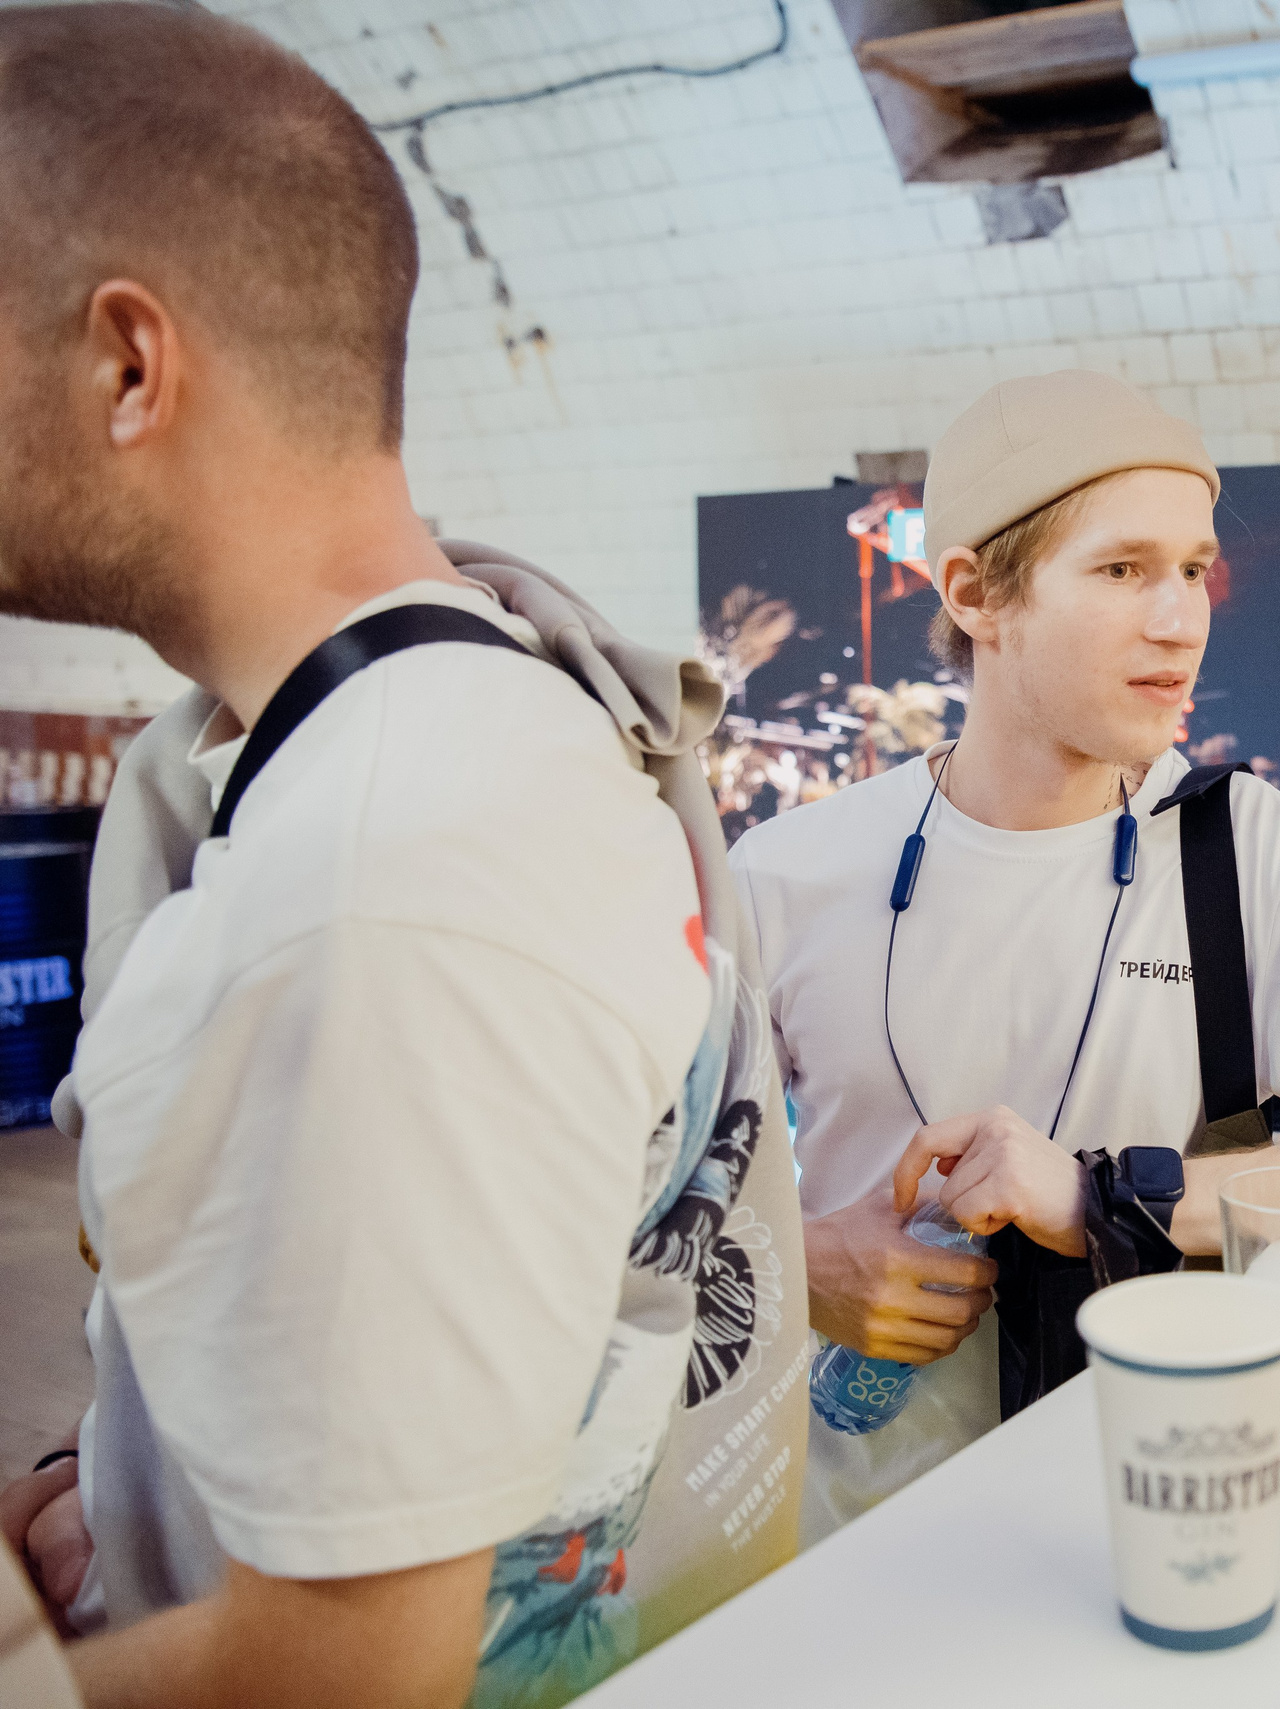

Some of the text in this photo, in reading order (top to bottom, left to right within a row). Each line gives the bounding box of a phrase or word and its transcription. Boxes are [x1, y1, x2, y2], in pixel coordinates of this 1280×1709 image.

[684, 1443, 730, 1493] MAKE
[724, 1396, 773, 1451] SMART
[722, 1445, 792, 1539] NEVER STOP
